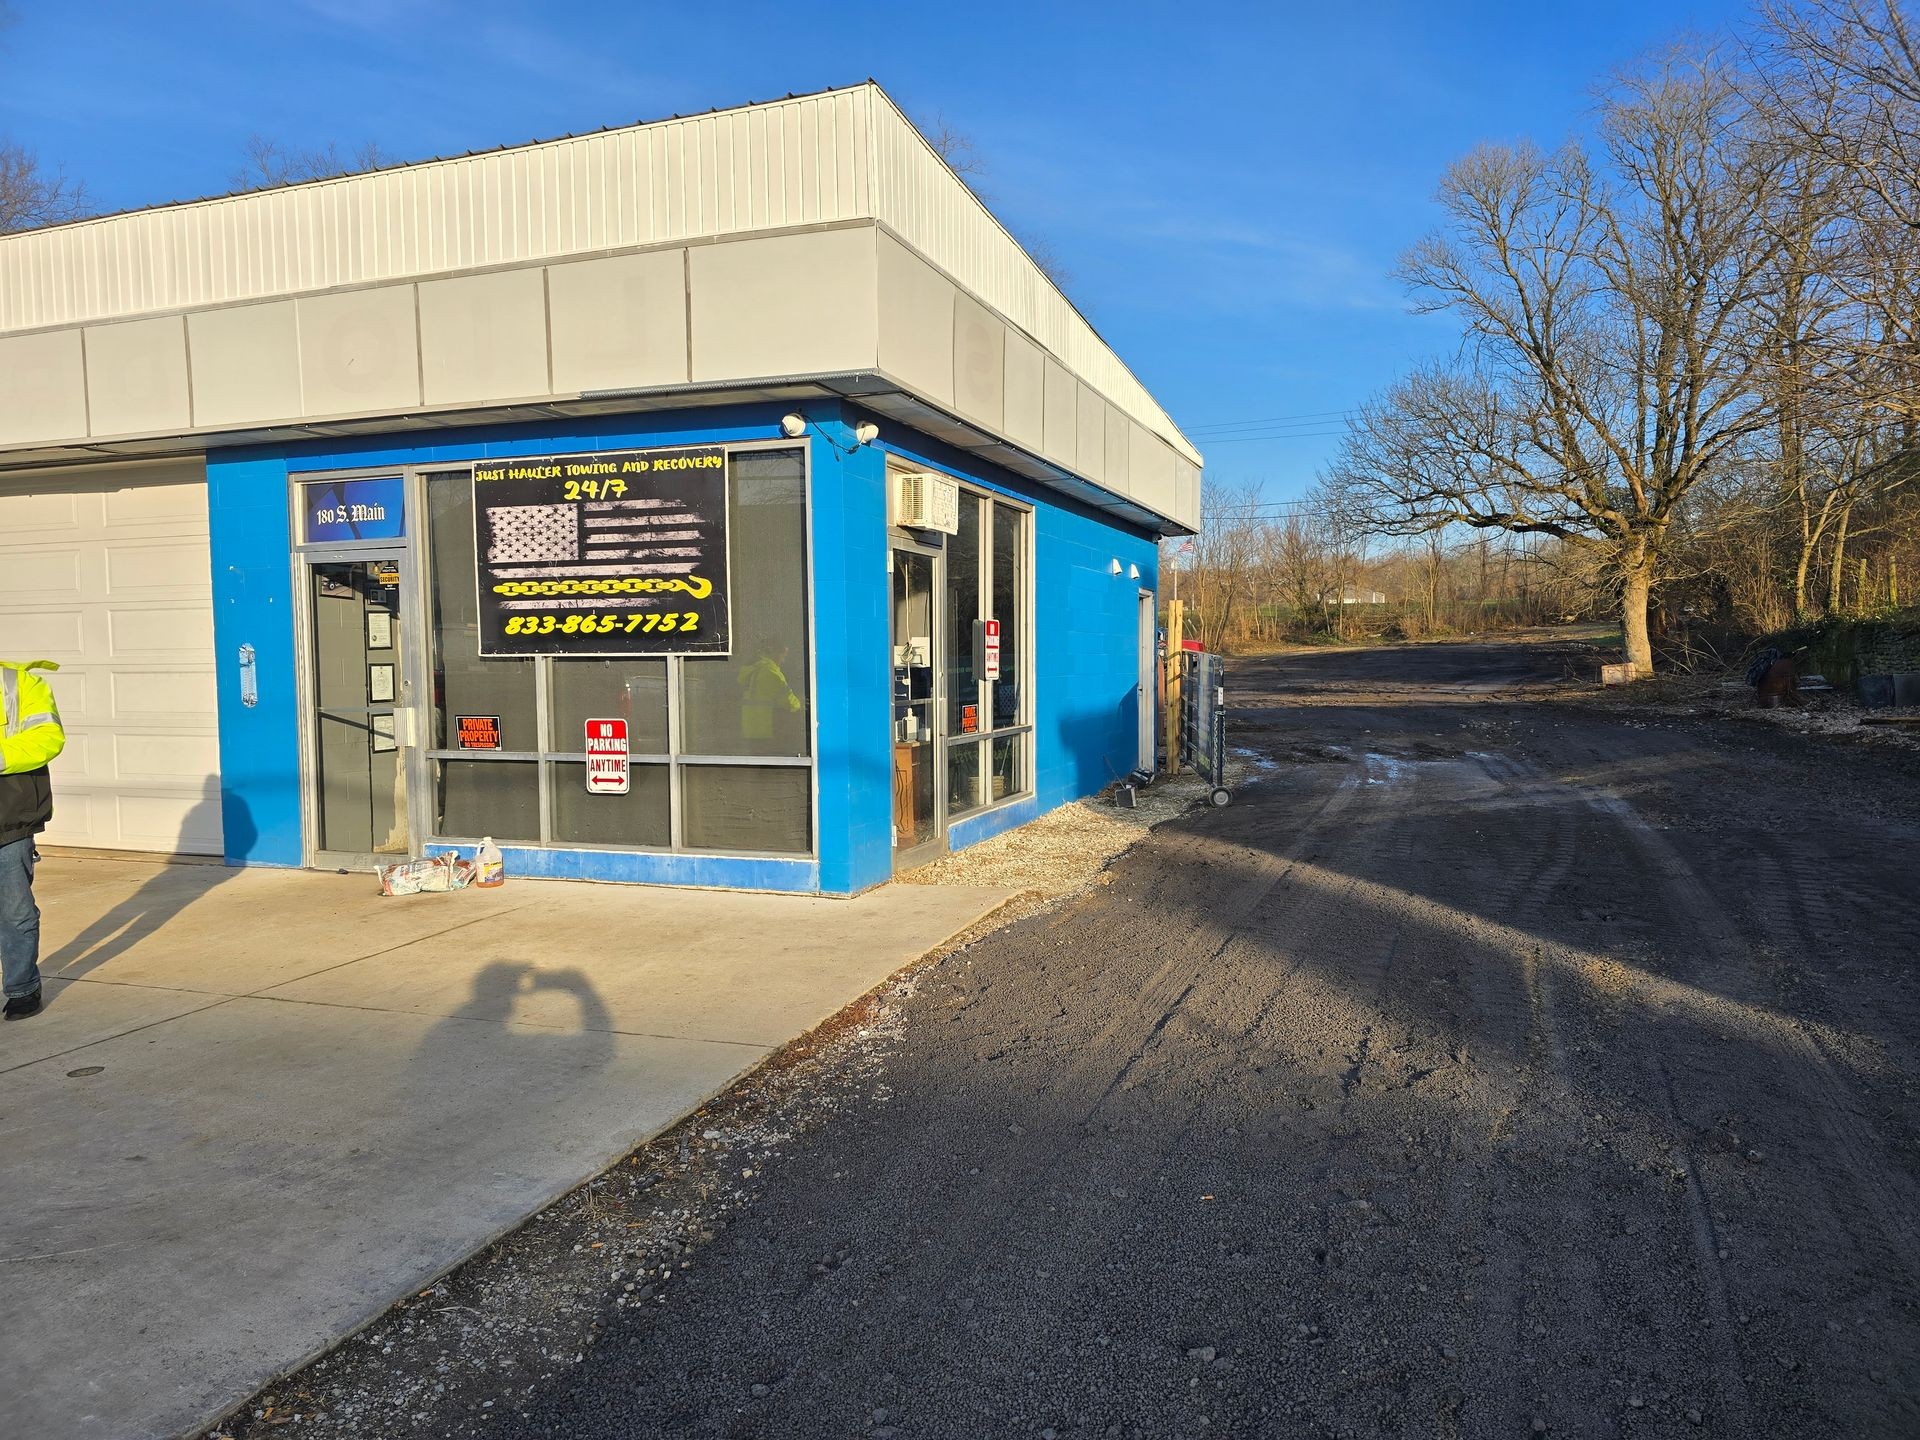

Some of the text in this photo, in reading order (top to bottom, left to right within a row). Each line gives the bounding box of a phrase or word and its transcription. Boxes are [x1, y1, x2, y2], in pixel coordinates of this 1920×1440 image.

[475, 468, 505, 481] JUST
[564, 462, 617, 476] TOWING
[622, 460, 650, 473] AND
[652, 456, 723, 471] RECOVERY
[563, 478, 628, 500] 24/7
[316, 502, 386, 525] 180 S. Main
[504, 611, 700, 635] 833-865-7752
[462, 718, 493, 731] PRIVATE
[600, 723, 613, 737] NO
[459, 730, 498, 742] PROPERTY
[588, 737, 627, 752] PARKING
[590, 758, 626, 773] ANYTIME
